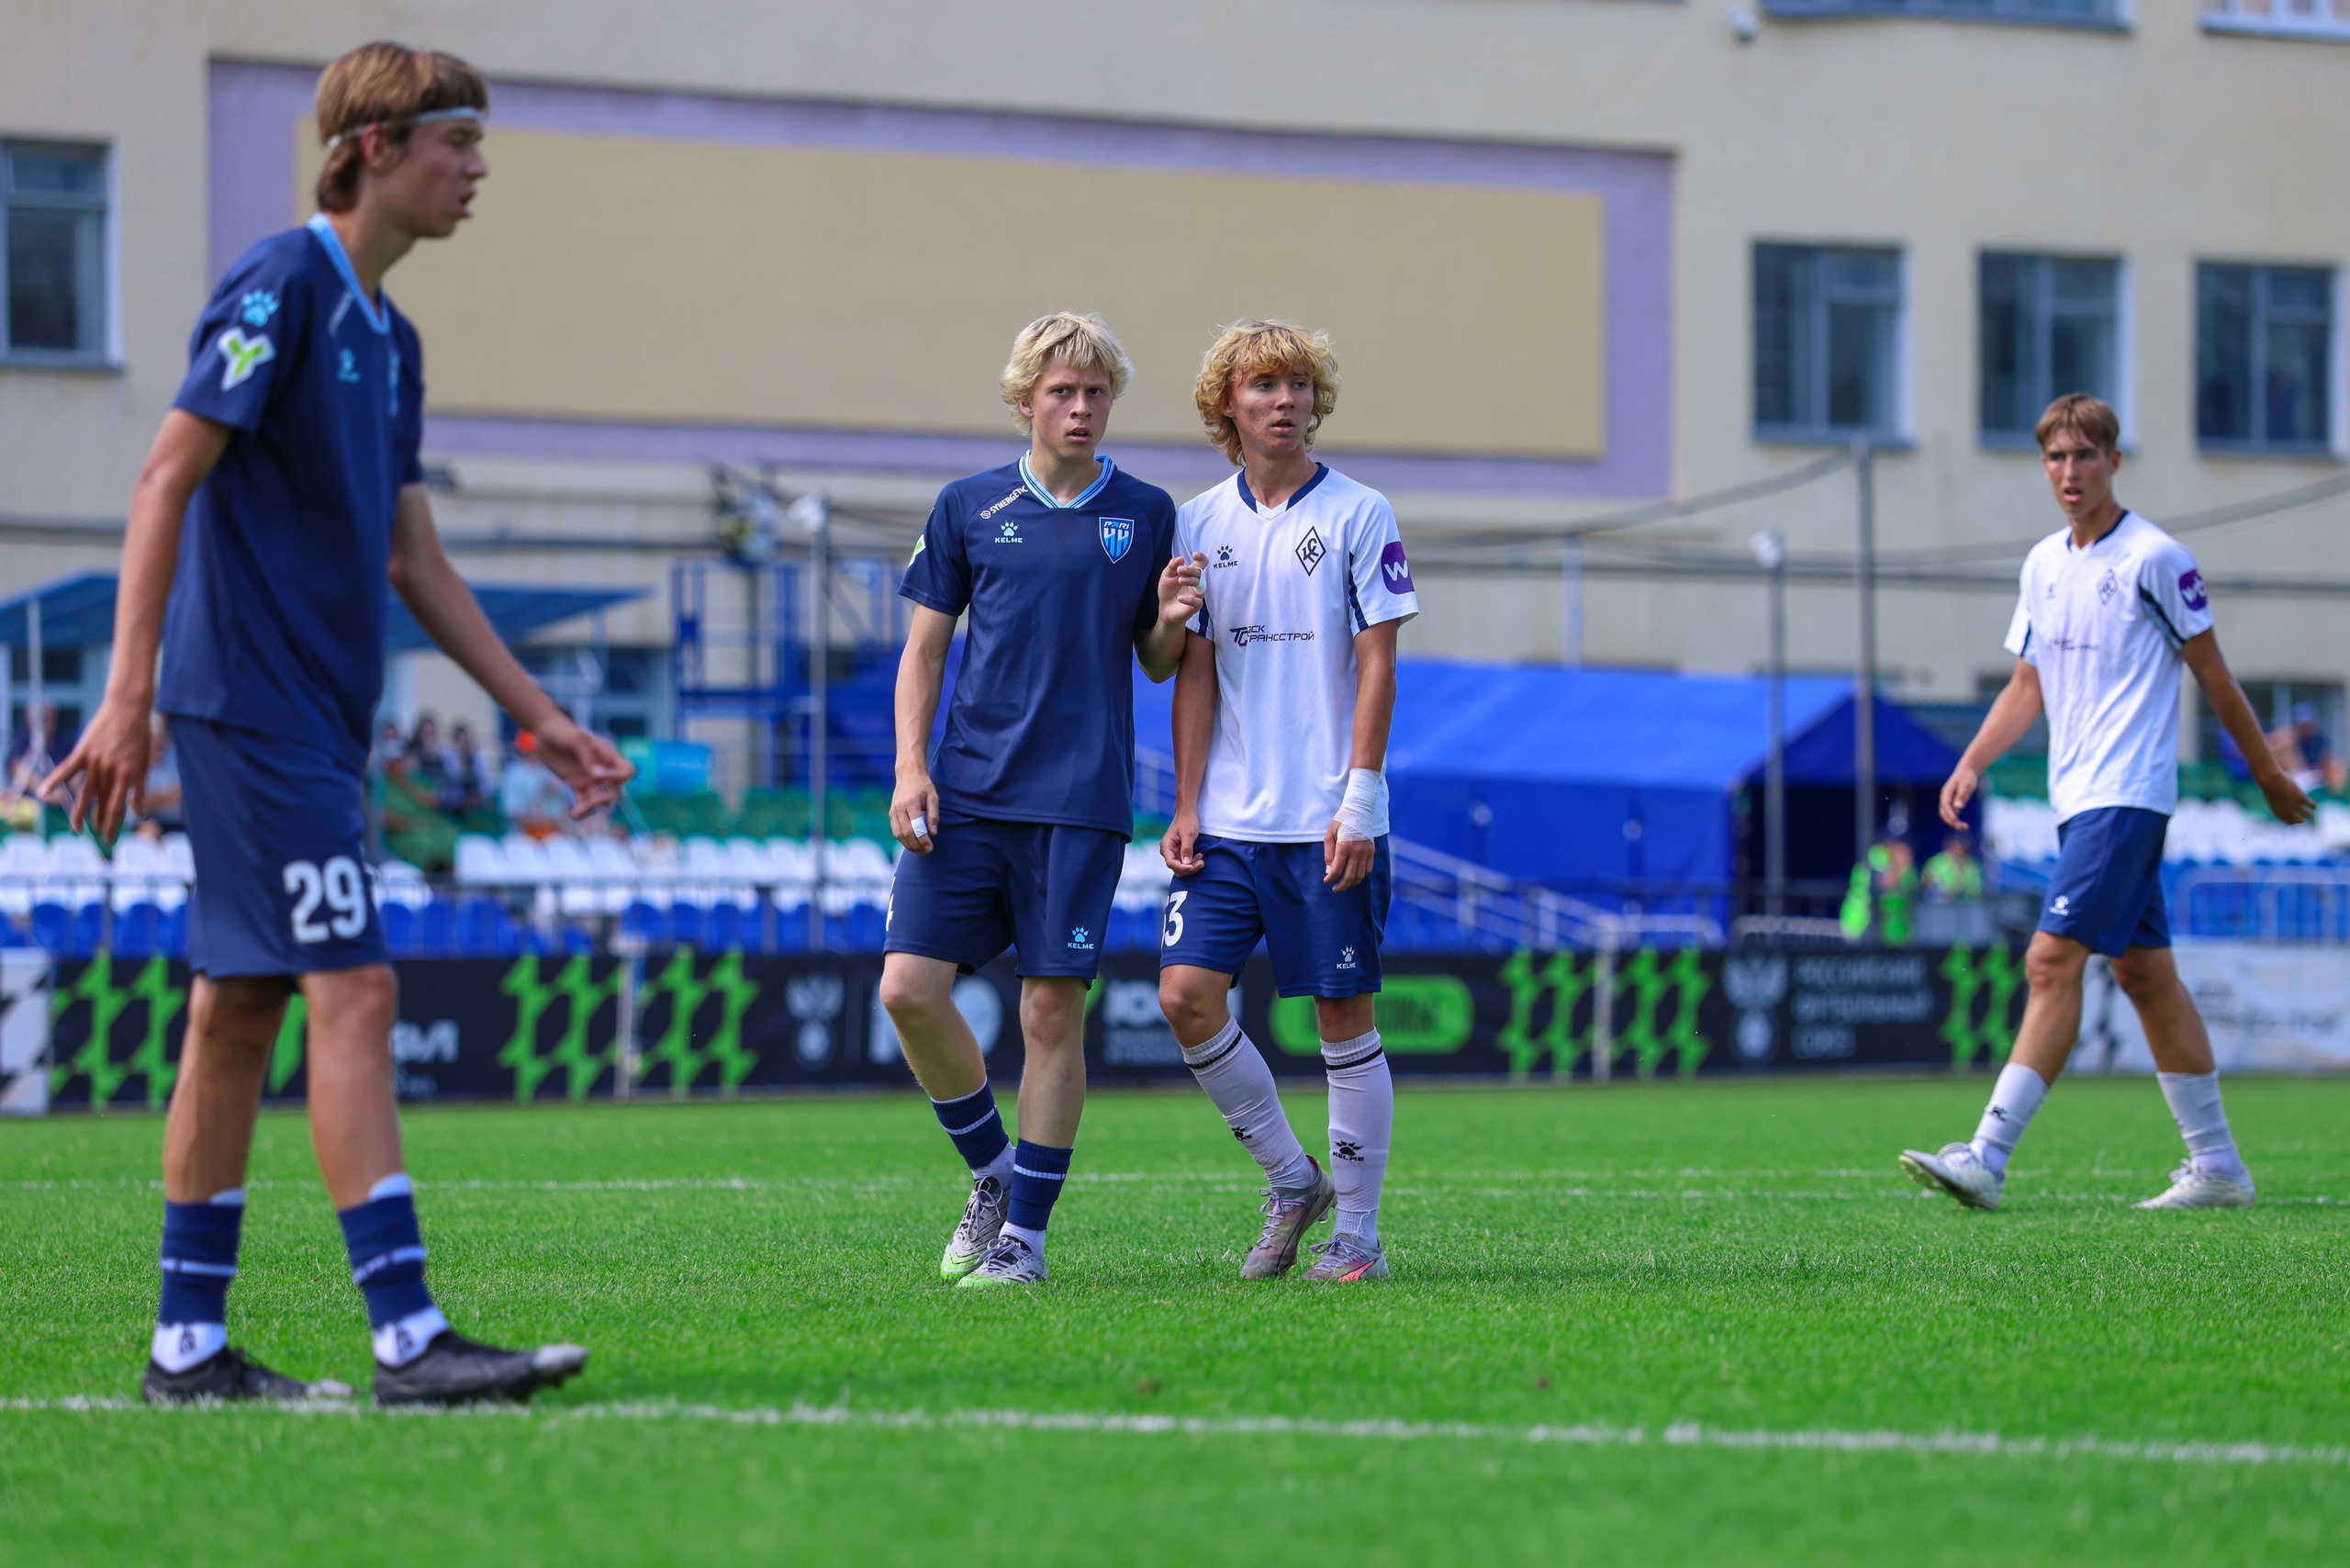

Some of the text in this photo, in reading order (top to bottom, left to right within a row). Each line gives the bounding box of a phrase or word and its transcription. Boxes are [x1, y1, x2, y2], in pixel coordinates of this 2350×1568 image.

[990, 485, 1029, 514] SYNERGETIC
[1213, 560, 1238, 569] KELME
[282, 855, 367, 944] 29
[1161, 890, 1188, 950] 3
[1332, 1151, 1364, 1162] KELME
